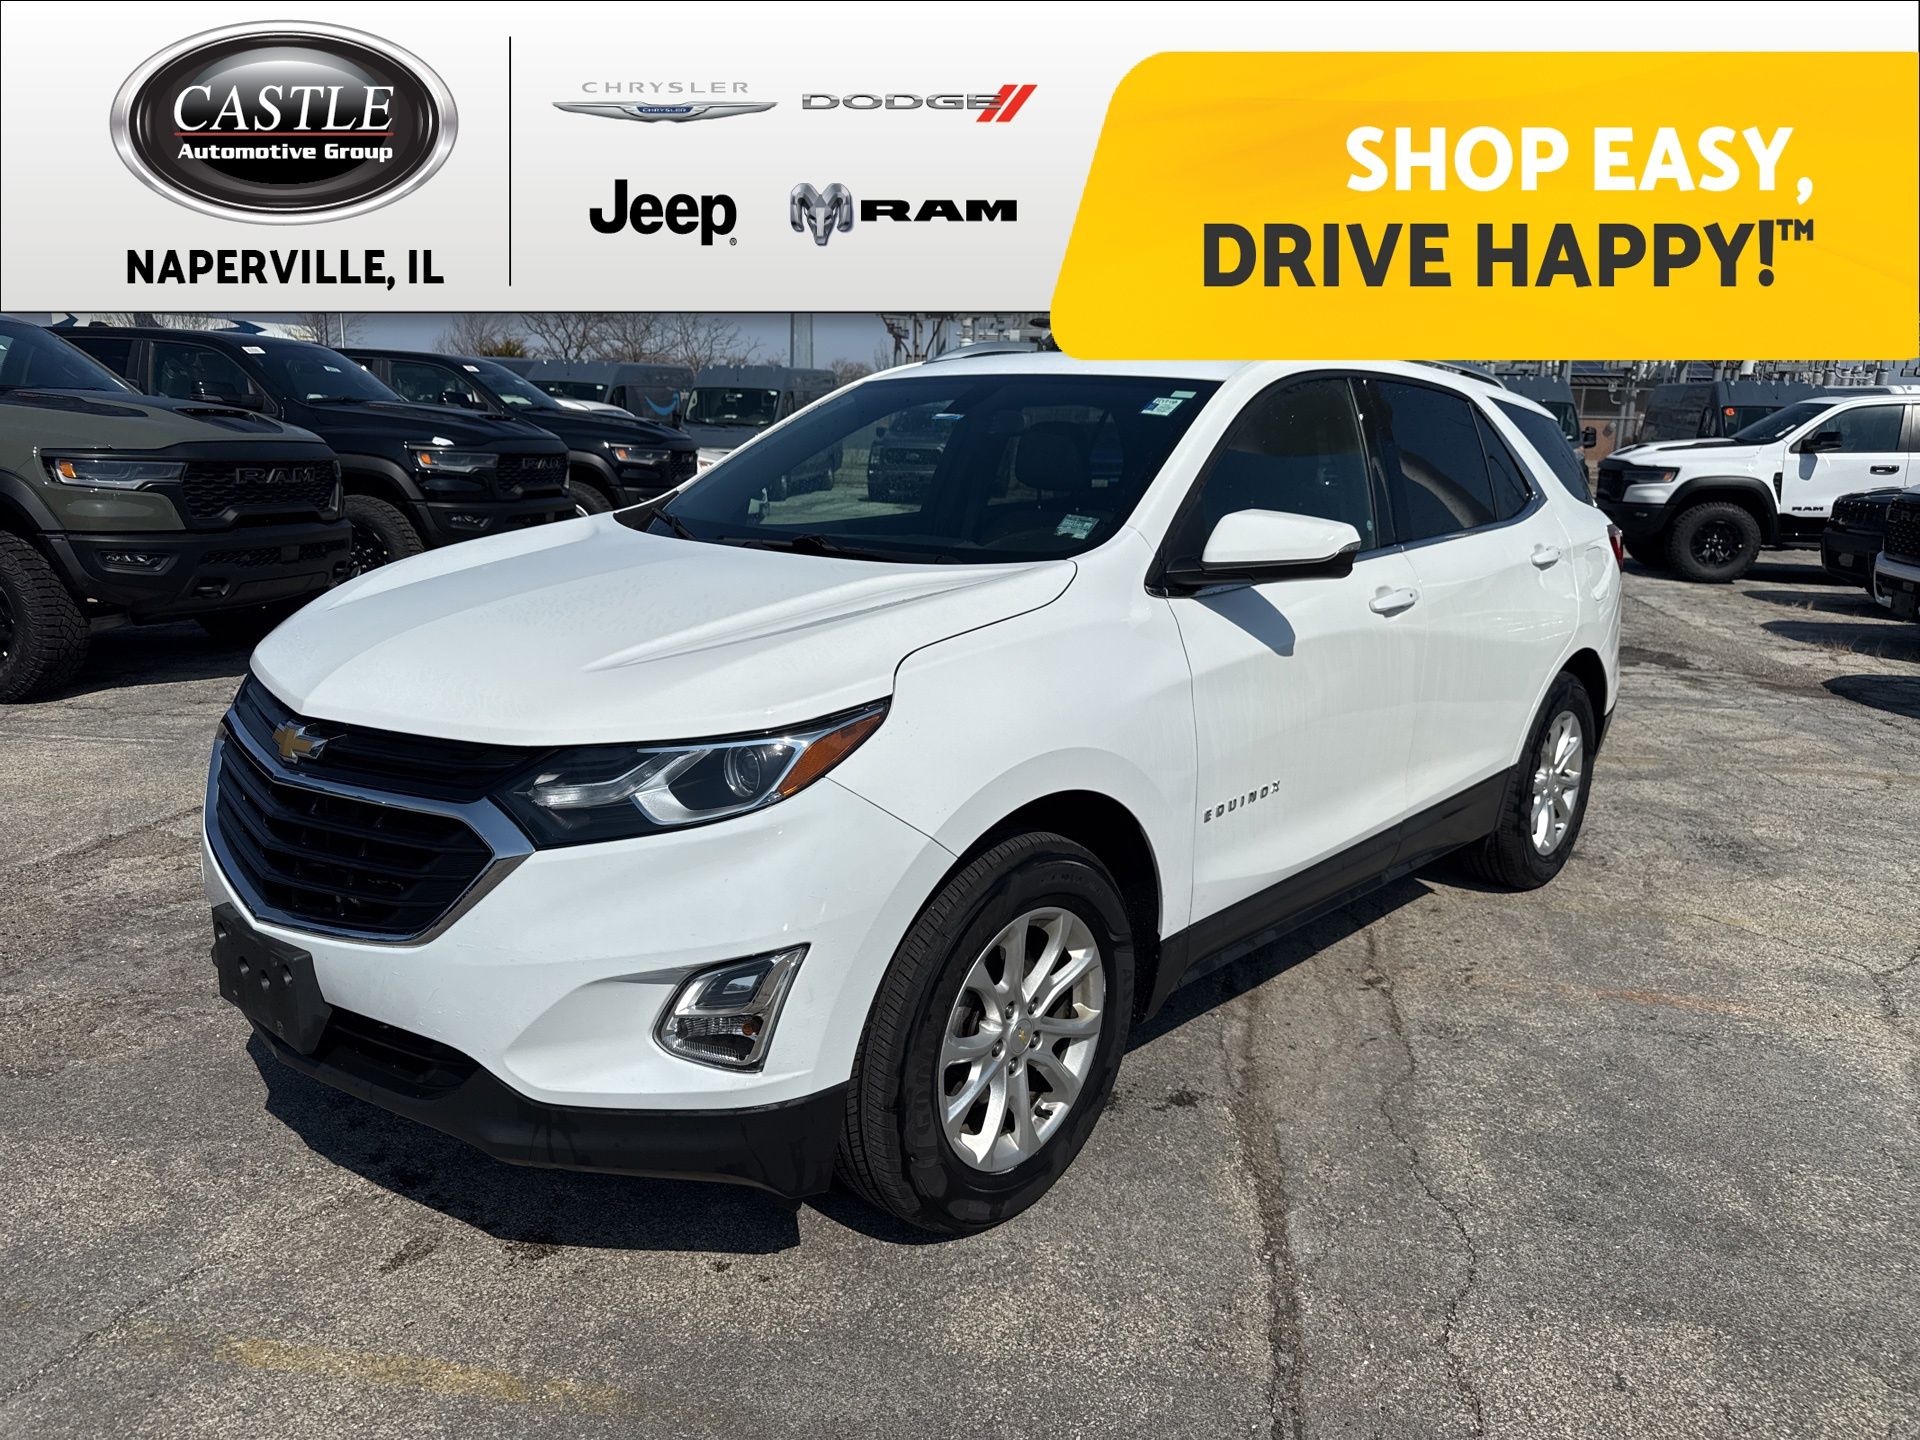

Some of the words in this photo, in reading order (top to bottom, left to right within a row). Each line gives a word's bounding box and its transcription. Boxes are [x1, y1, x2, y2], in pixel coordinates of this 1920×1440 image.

[521, 456, 562, 470] RAM
[234, 466, 315, 484] RAM
[1203, 780, 1281, 824] EQUINOX
